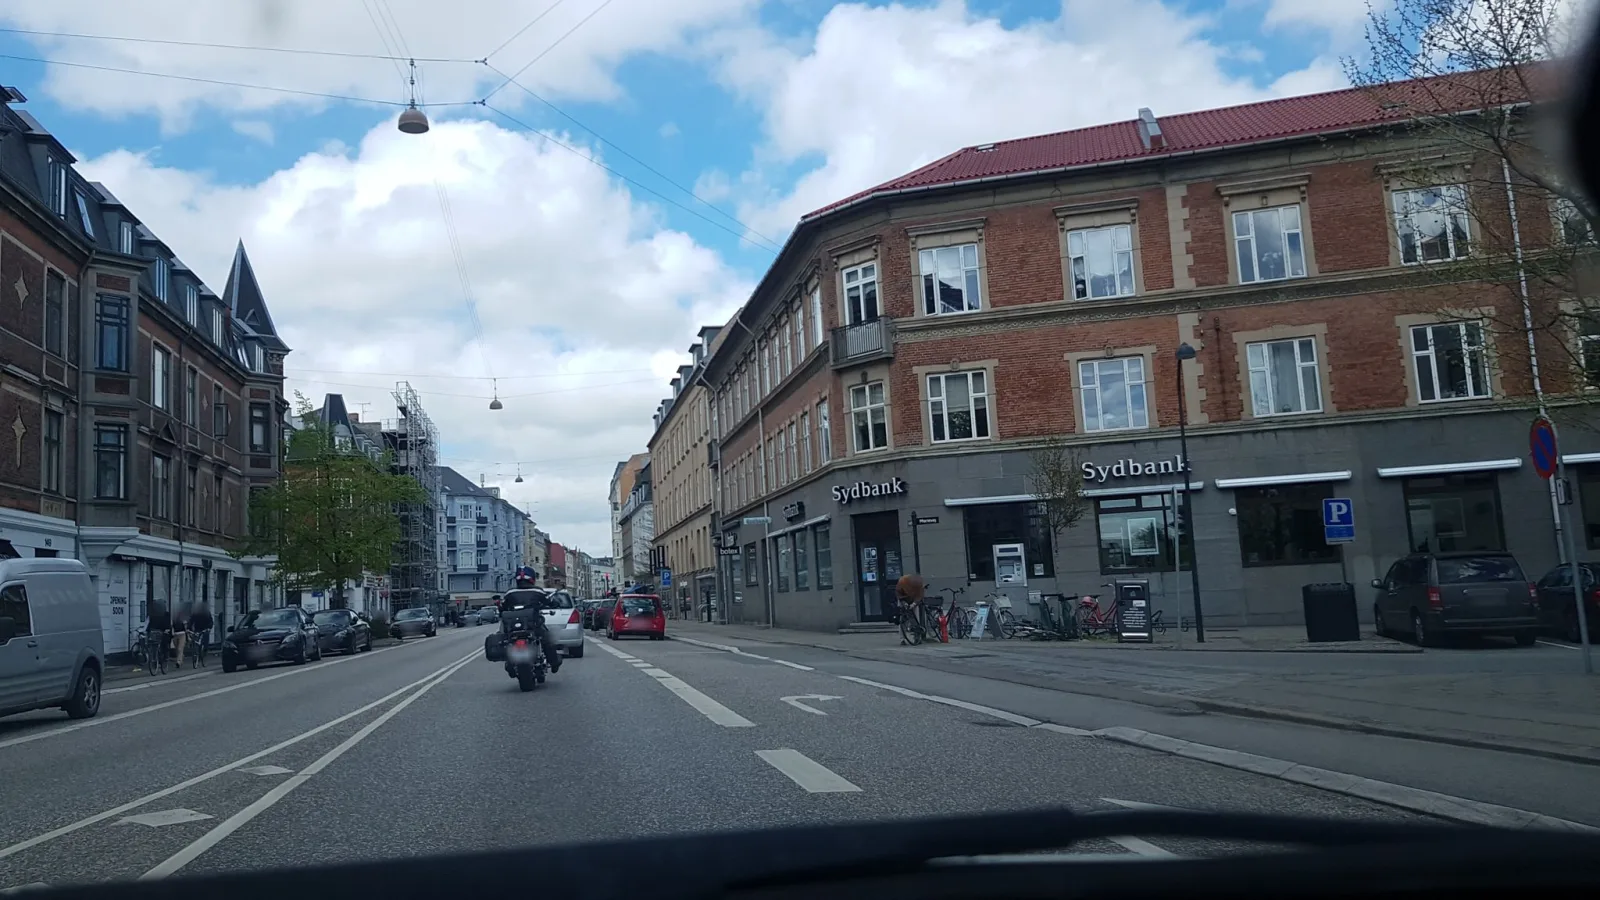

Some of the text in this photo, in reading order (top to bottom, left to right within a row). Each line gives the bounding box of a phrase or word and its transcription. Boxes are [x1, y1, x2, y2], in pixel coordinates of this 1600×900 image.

[1081, 454, 1192, 482] Sydbank
[832, 477, 903, 504] Sydbank
[1328, 502, 1348, 522] P
[110, 596, 127, 604] OPENING
[112, 606, 124, 615] SOON
